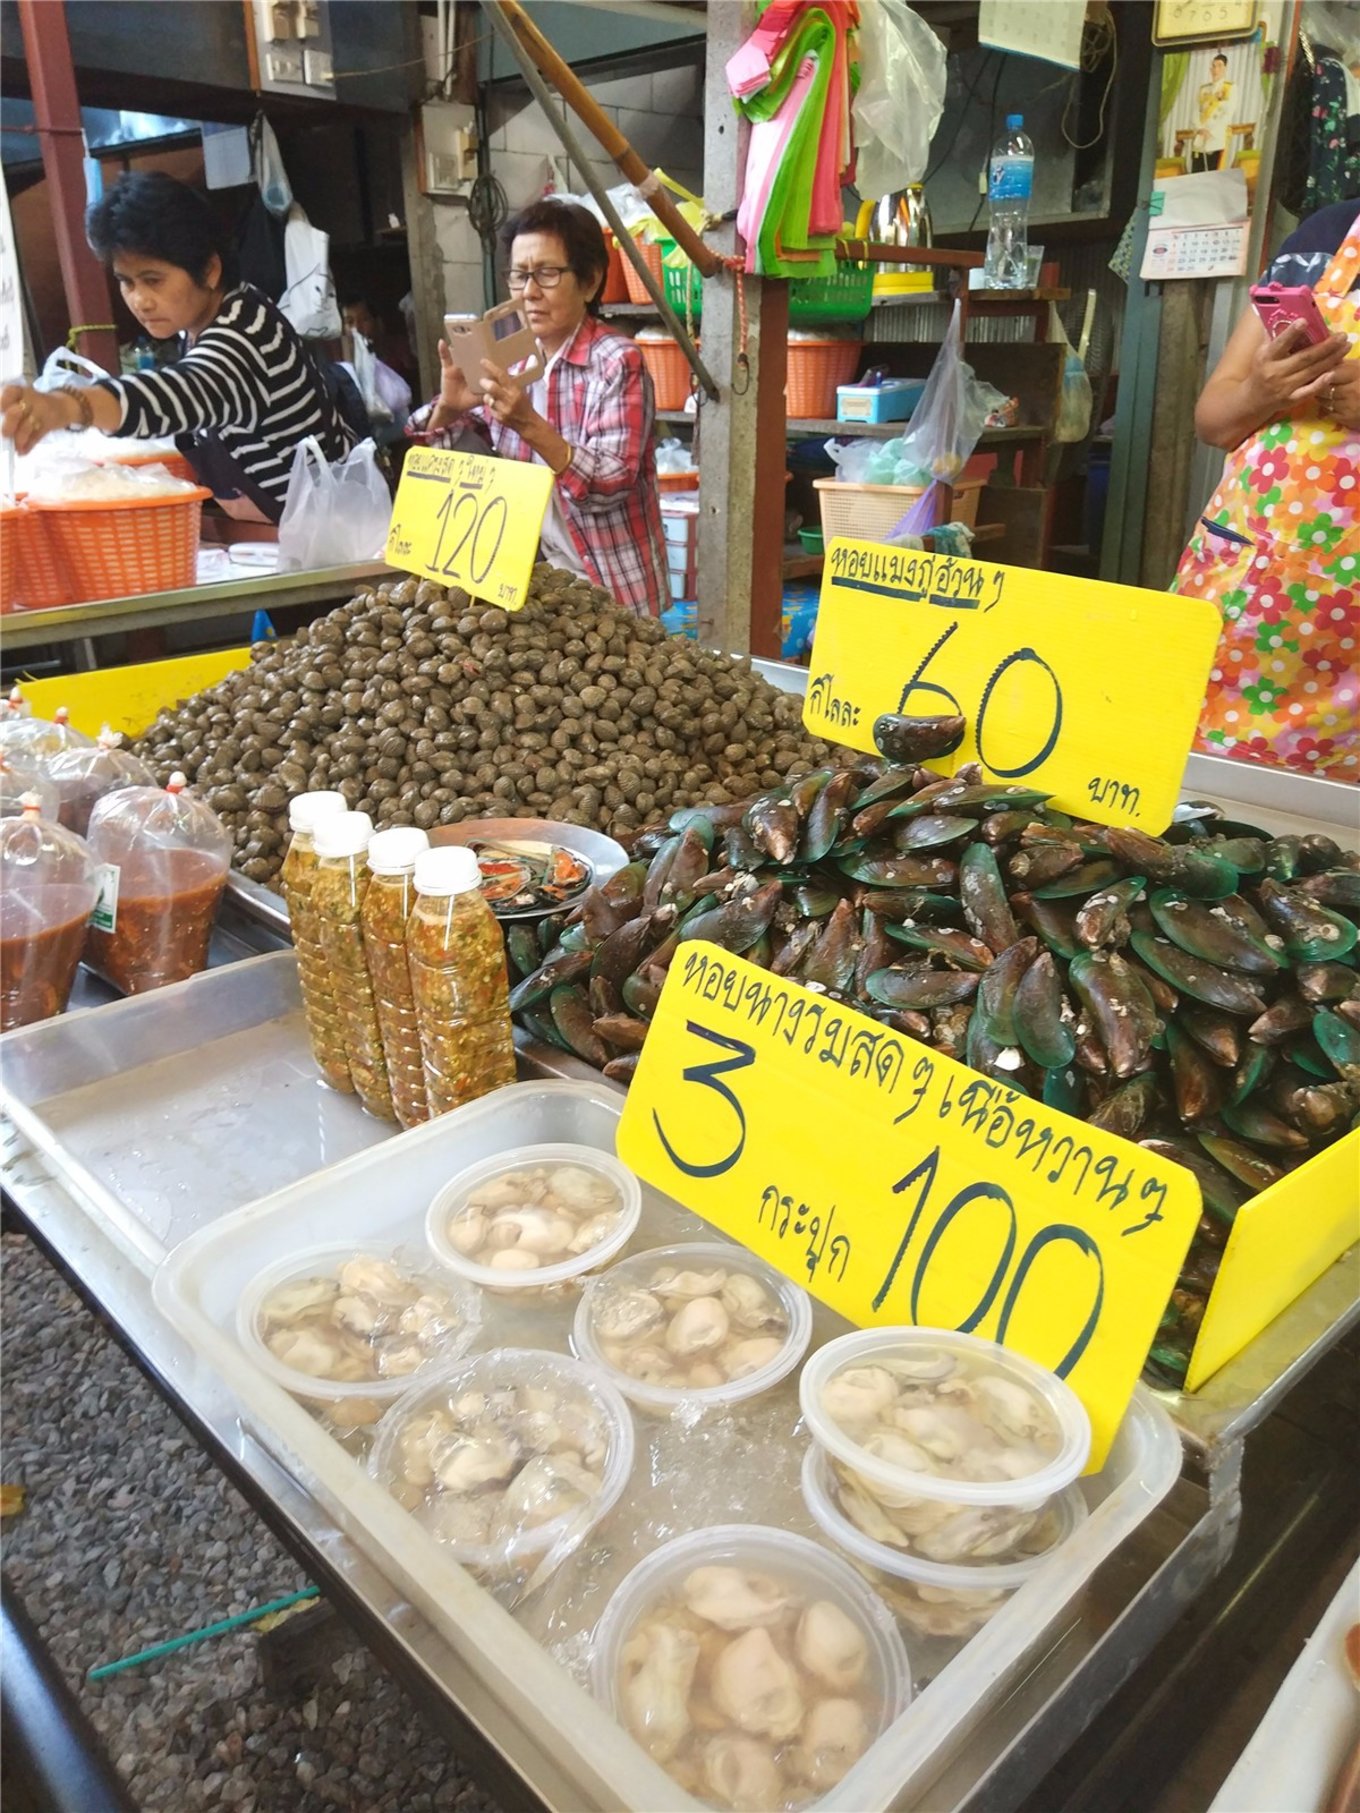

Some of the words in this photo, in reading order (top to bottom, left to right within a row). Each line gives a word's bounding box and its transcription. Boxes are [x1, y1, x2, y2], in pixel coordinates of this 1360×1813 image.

[425, 487, 508, 584] 120
[898, 621, 1063, 778] 60
[653, 1020, 756, 1178] 3
[873, 1146, 1104, 1381] 100
